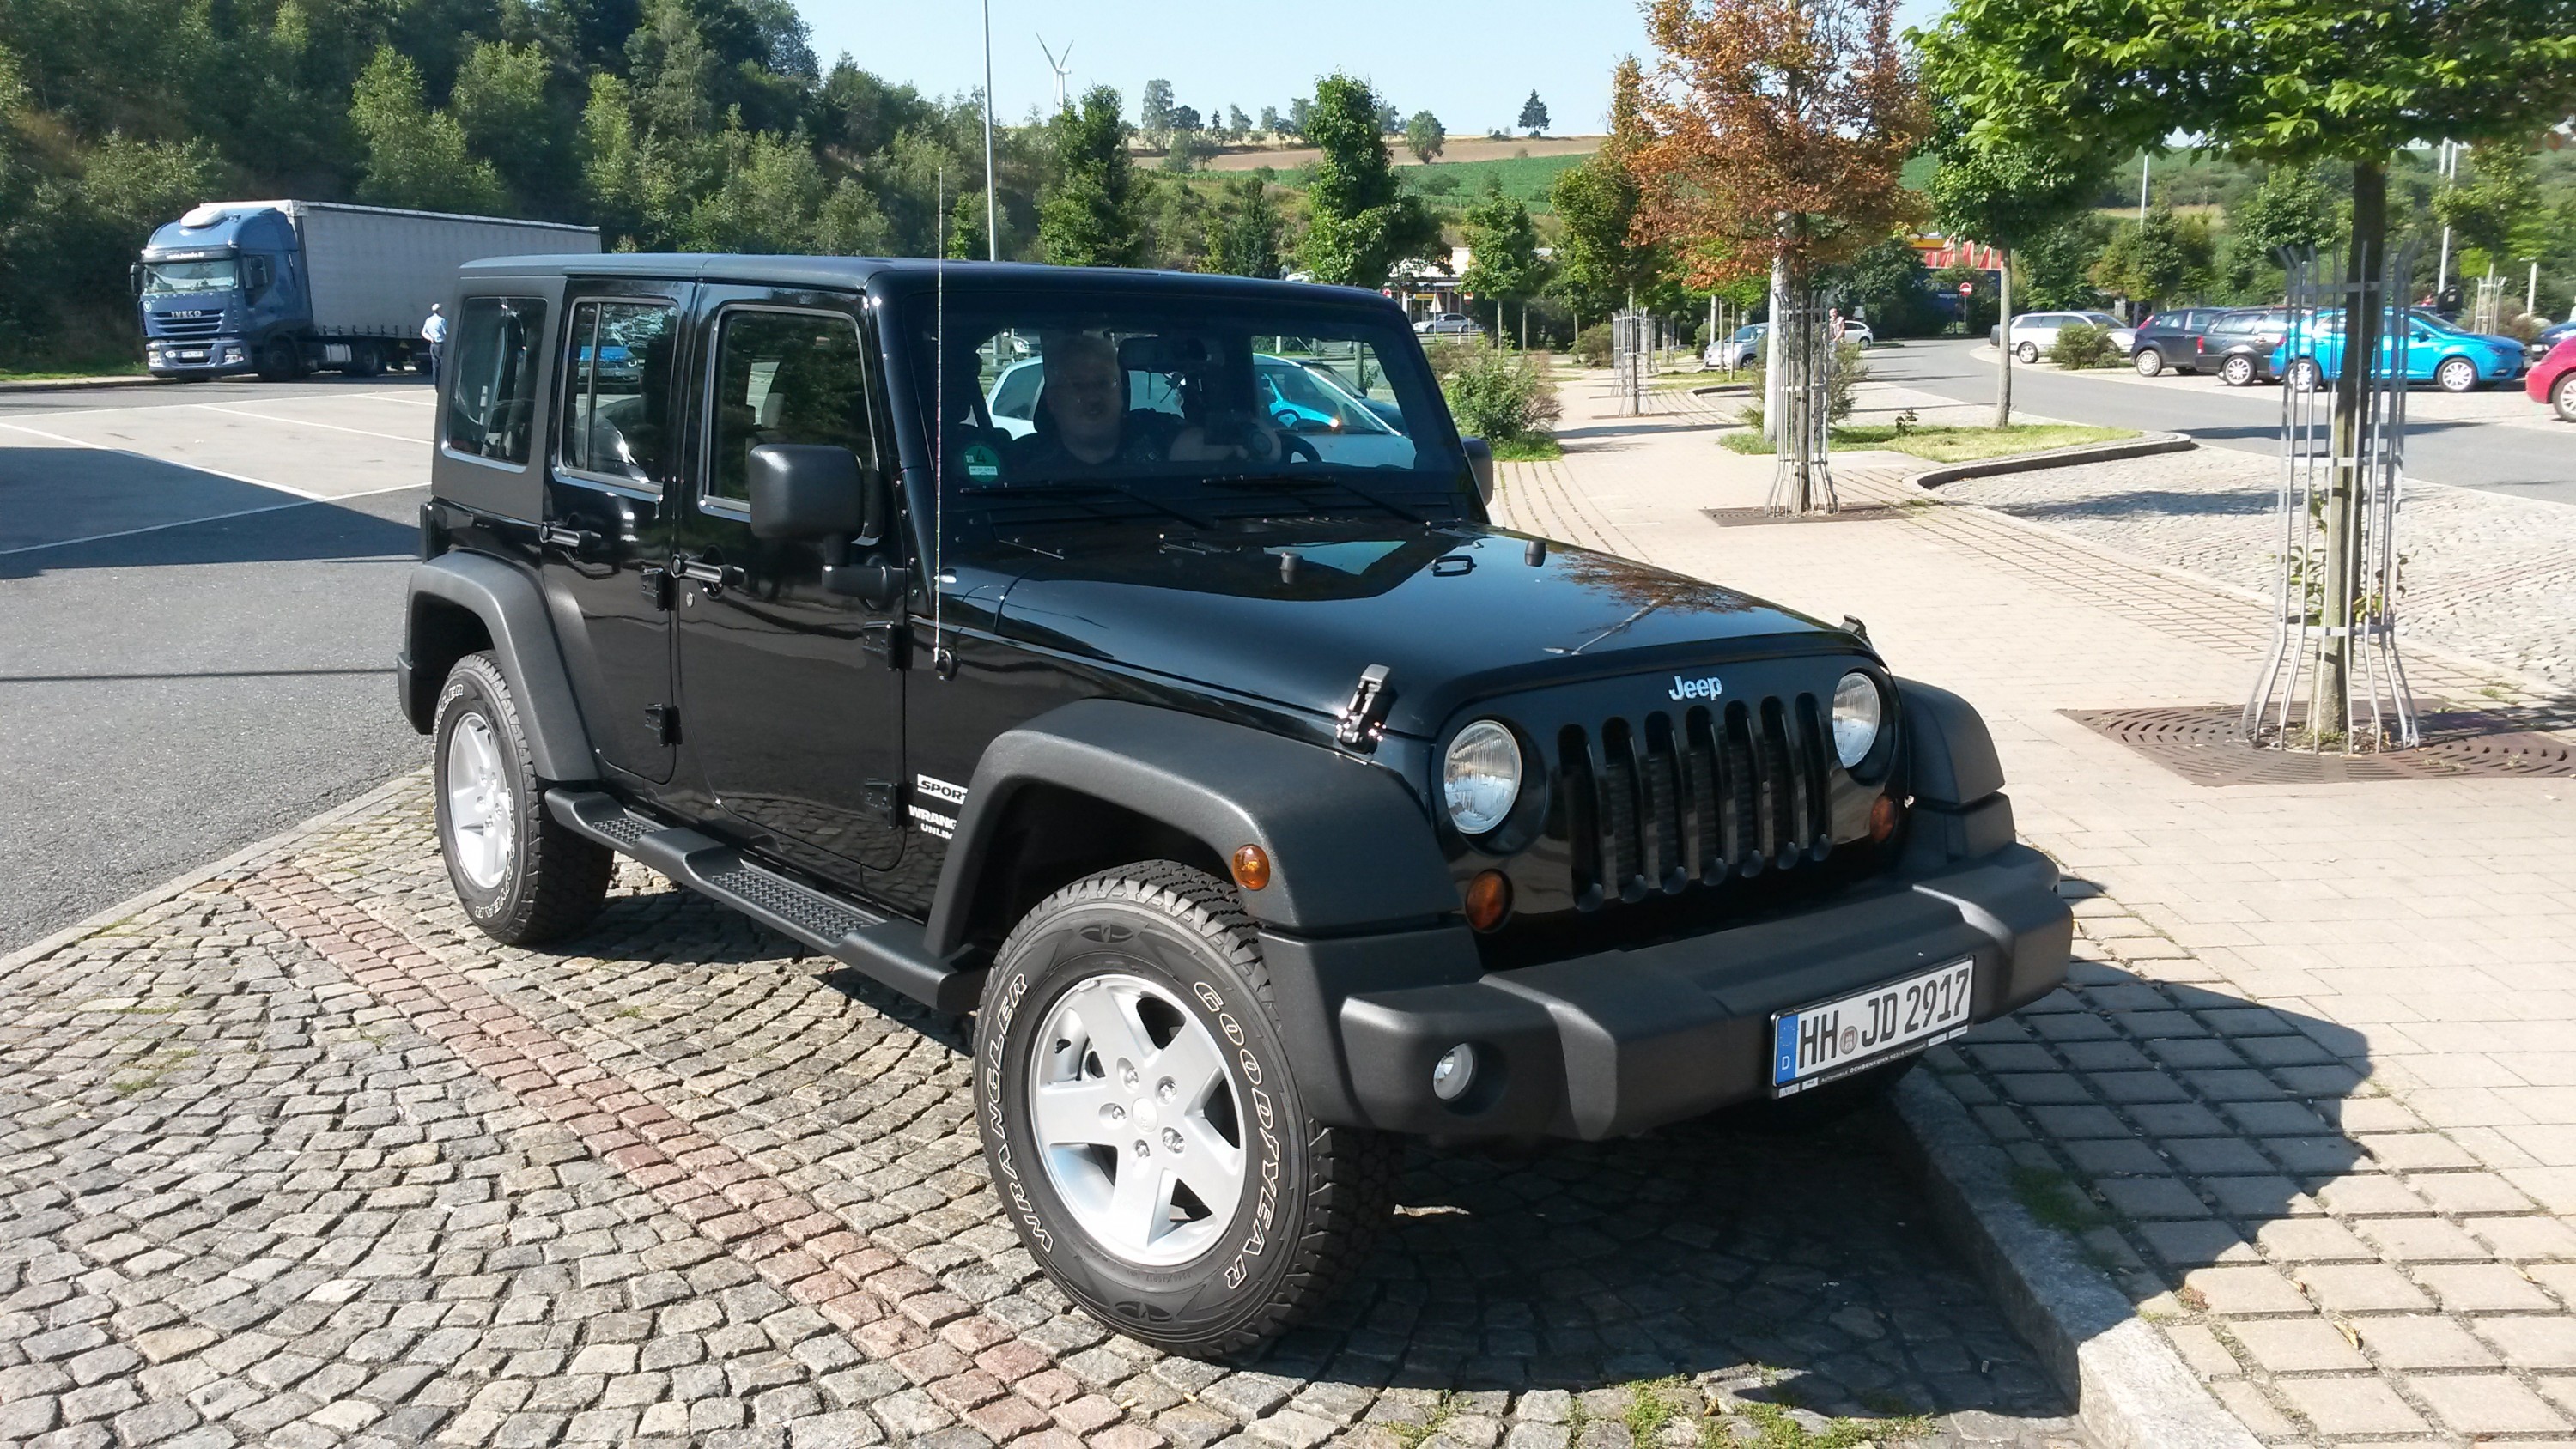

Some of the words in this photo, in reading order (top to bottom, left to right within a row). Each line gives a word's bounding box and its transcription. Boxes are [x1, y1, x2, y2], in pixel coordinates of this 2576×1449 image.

[976, 448, 987, 464] 4
[1668, 676, 1722, 701] Jeep
[918, 780, 967, 800] SPOR
[1782, 1055, 1790, 1070] D
[1799, 1009, 1838, 1070] HH
[1861, 992, 1898, 1048] JD
[1904, 967, 1970, 1034] 2917
[985, 973, 1054, 1255] WRANGLER
[1194, 981, 1279, 1289] GOODYEAR
